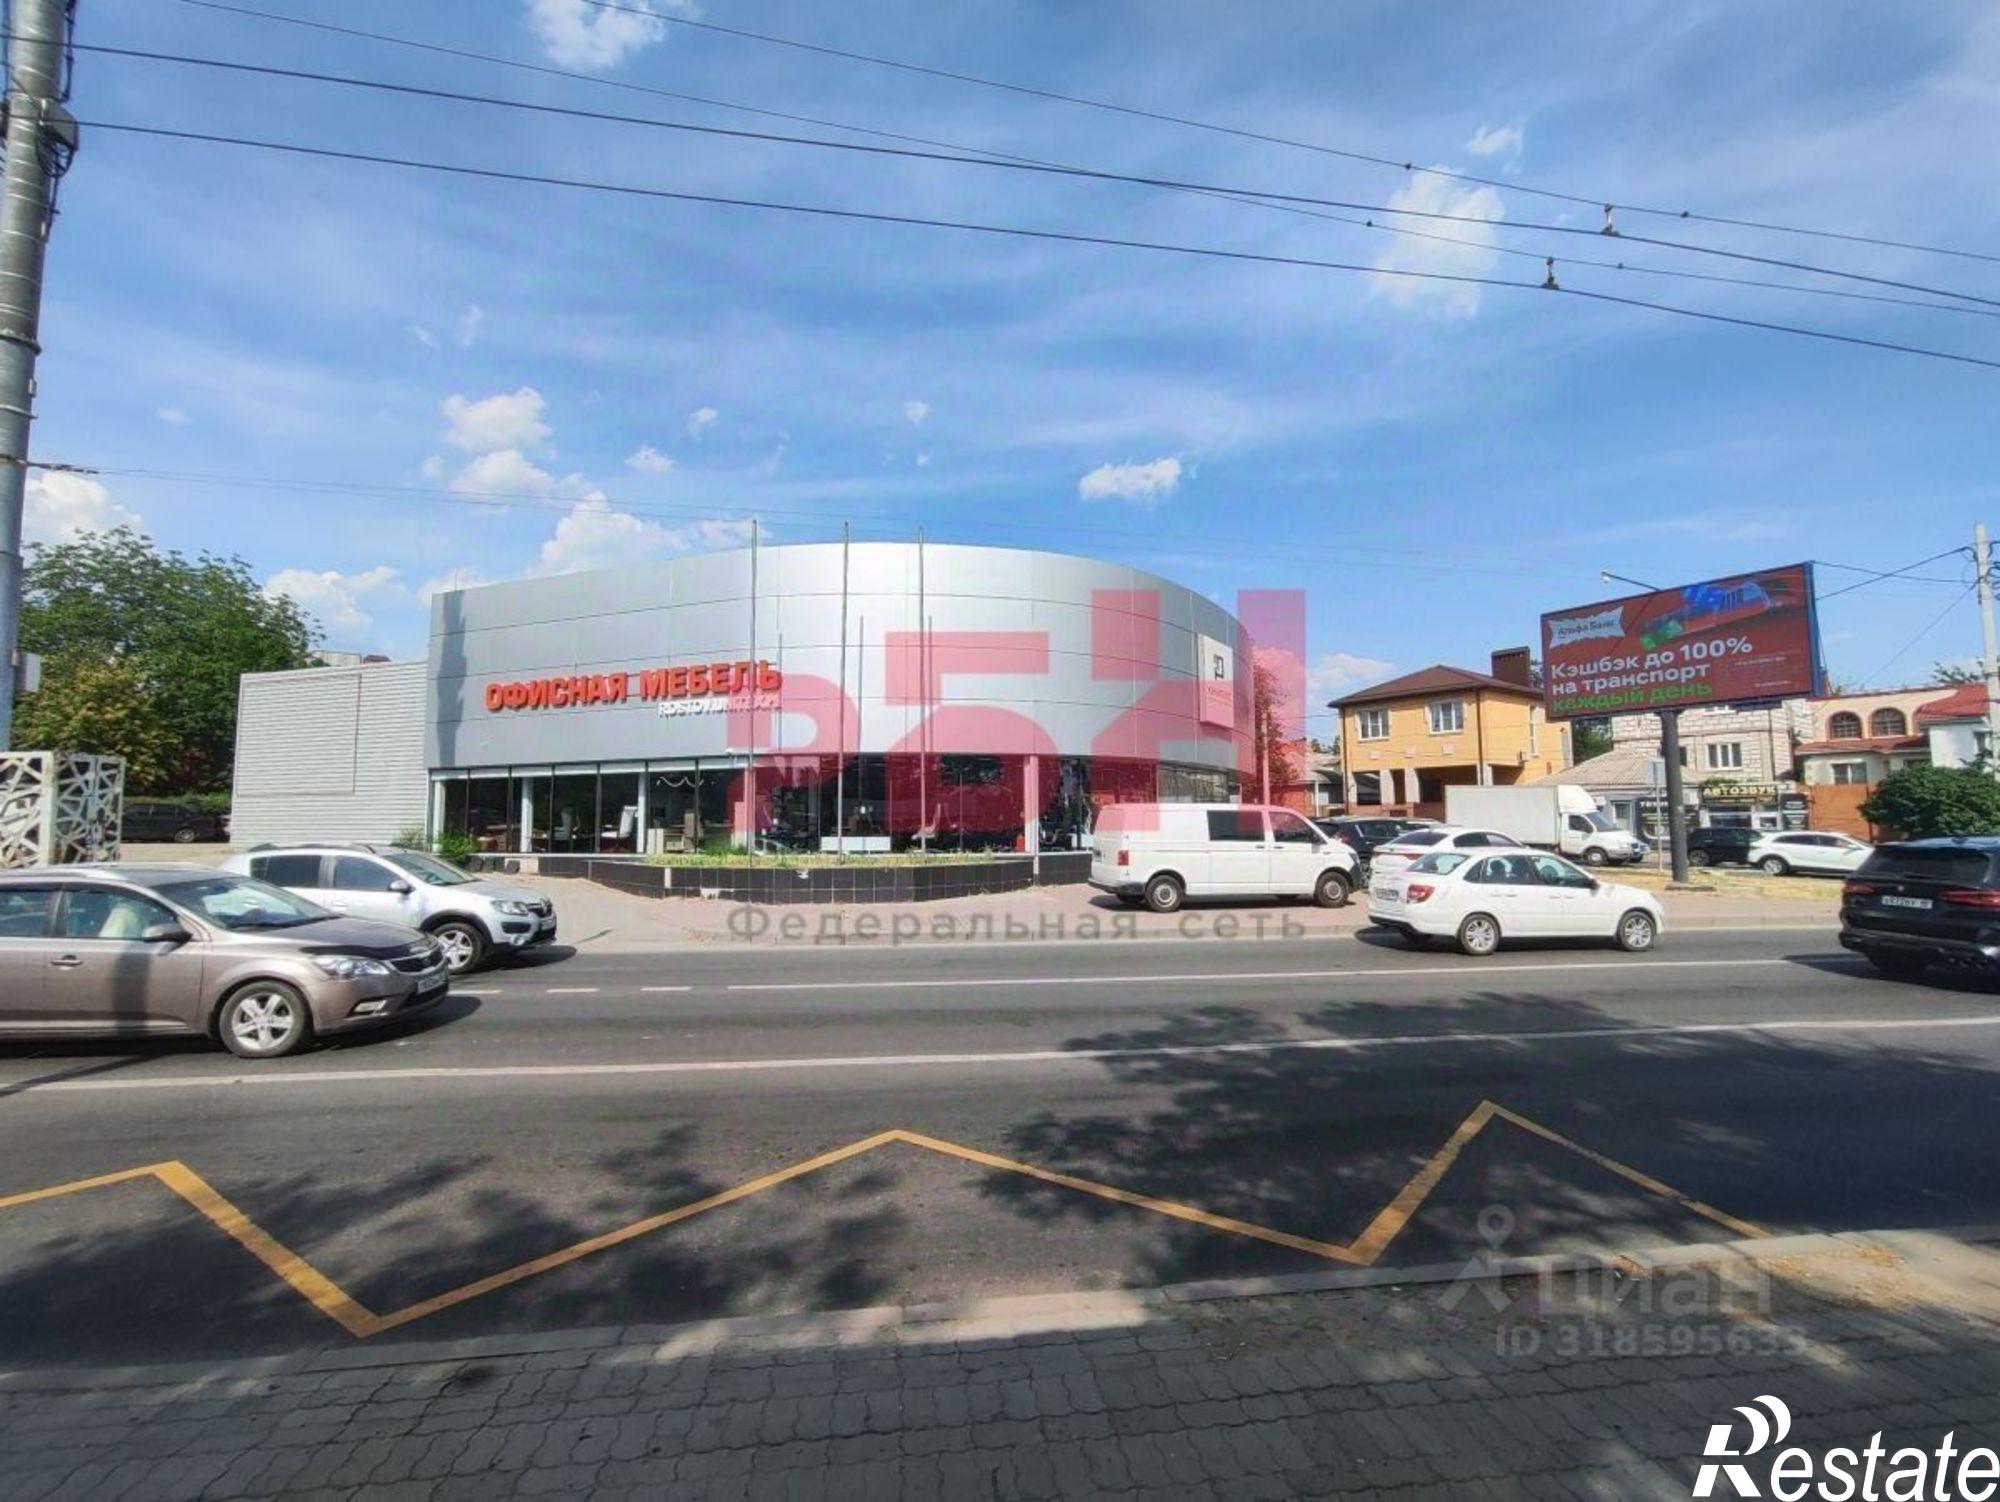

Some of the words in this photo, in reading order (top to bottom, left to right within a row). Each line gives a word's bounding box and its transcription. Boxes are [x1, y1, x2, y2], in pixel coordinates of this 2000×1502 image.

[1551, 656, 1640, 679] Кэшбэк
[1644, 651, 1675, 669] до
[1680, 636, 1753, 661] 100%
[484, 672, 629, 713] ОФИСНАЯ
[639, 660, 782, 702] МЕБЕЛЬ
[1552, 681, 1577, 695] на
[1582, 664, 1710, 694] транспорт
[1554, 688, 1643, 711] каждый
[1650, 683, 1713, 702] день
